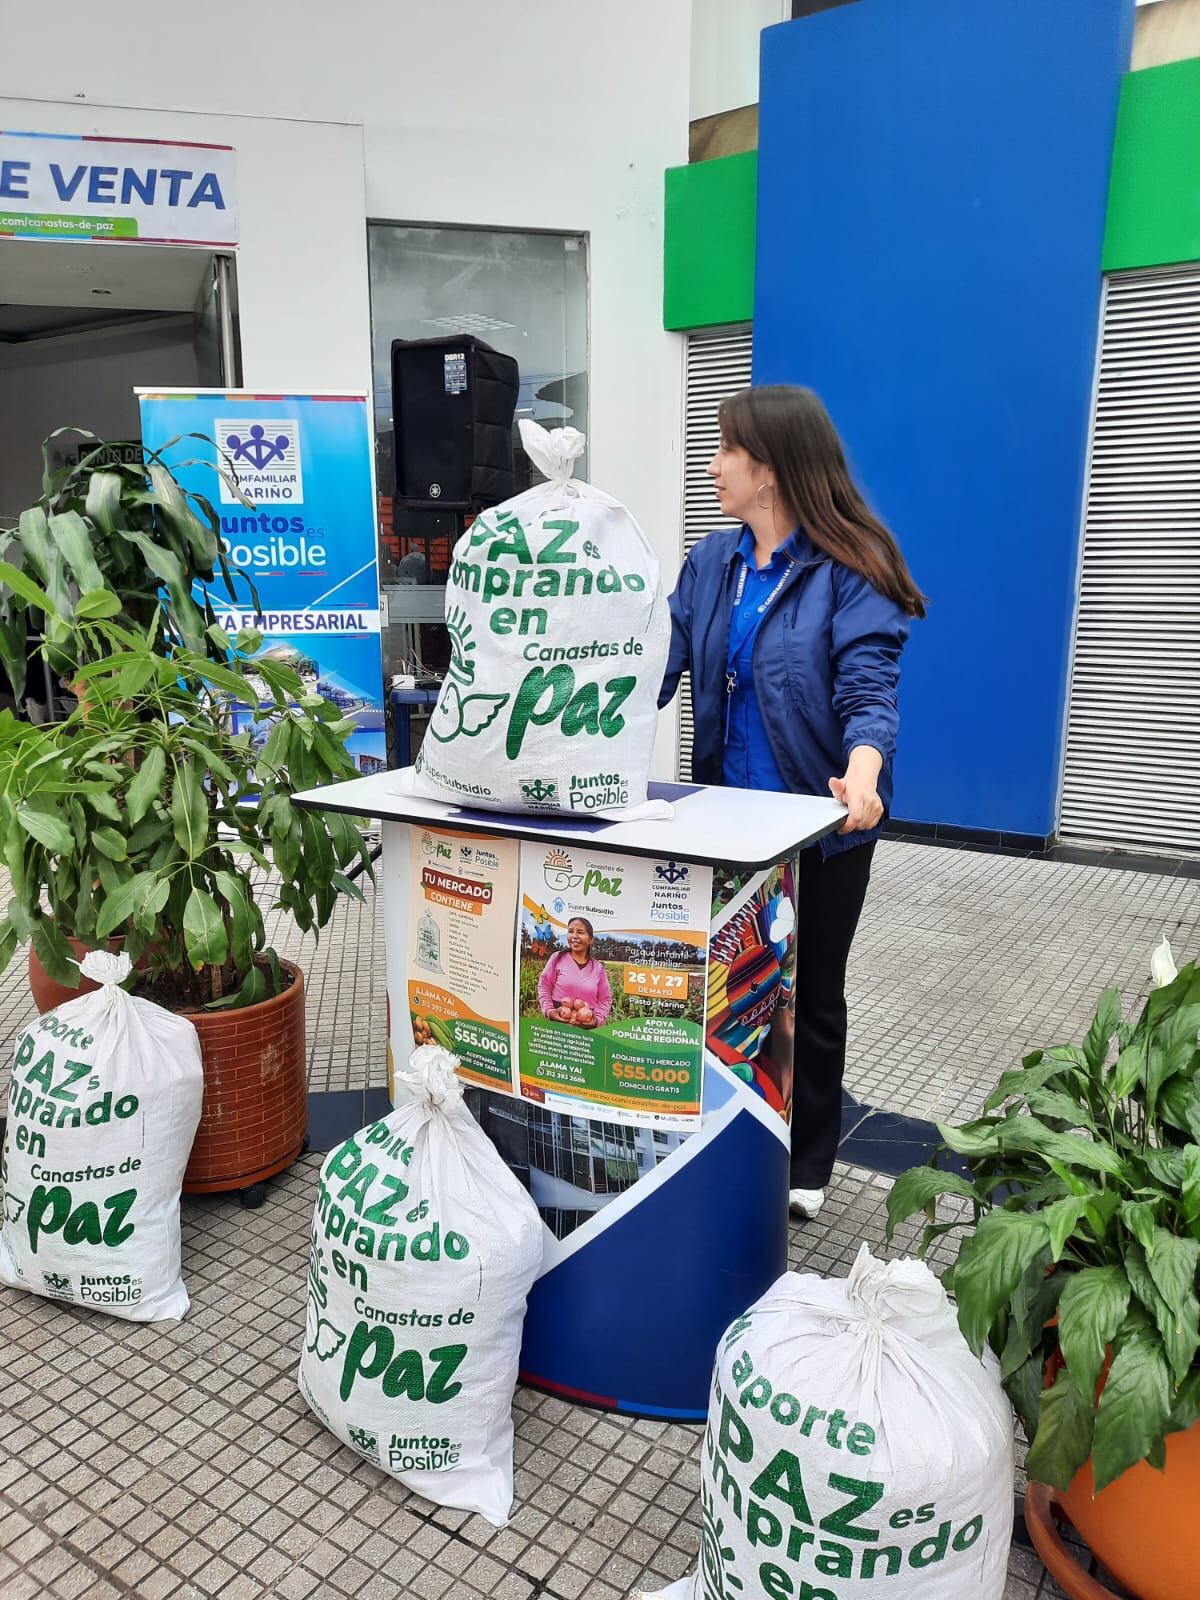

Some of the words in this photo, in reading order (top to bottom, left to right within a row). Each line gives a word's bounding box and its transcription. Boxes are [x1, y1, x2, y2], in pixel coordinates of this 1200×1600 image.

[49, 163, 226, 210] VENTA
[231, 484, 293, 499] ARIÑO
[221, 512, 305, 534] untos
[306, 528, 325, 539] es
[462, 516, 580, 565] PAZ
[582, 540, 601, 560] es
[449, 559, 646, 604] omprando
[241, 613, 368, 631] EMPRESARIAL
[489, 607, 549, 636] en
[522, 639, 620, 662] Canastas
[623, 637, 643, 656] de
[569, 773, 620, 790] Juntos
[620, 779, 628, 787] es
[570, 788, 629, 810] Posible
[475, 849, 496, 859] Juntos
[586, 861, 615, 872] Canastas
[615, 865, 624, 873] de
[424, 872, 436, 884] TU
[437, 877, 491, 899] MERCADO
[654, 890, 688, 900] NARIÑO
[430, 892, 473, 911] CONTIENE
[567, 902, 615, 916] SuperSubsidio
[651, 900, 684, 911] Juntos
[650, 909, 690, 922] Posible
[625, 946, 656, 957] Parque
[657, 949, 689, 960] Infantil
[628, 955, 683, 969] Comfamiliar
[628, 971, 647, 984] 26
[651, 974, 661, 986] Y
[665, 975, 684, 987] 27
[638, 986, 648, 994] DE
[649, 987, 673, 996] MAYO
[629, 997, 651, 1006] Pasto
[643, 1027, 688, 1037] ECONOMÍA
[645, 1019, 674, 1028] APOYA
[454, 1027, 508, 1056] $55.000
[612, 1029, 653, 1042] POPULAR
[653, 1035, 700, 1045] REGIONAL
[13, 1033, 93, 1102] PAZ
[87, 1075, 101, 1091] s
[611, 1053, 646, 1063] ADQUIERE
[655, 1059, 691, 1067] MERCADO
[612, 1060, 690, 1083] $55.000
[619, 1081, 655, 1091] DOMICILIO
[655, 1085, 680, 1094] GRATIS
[8, 1075, 139, 1129] mprando
[16, 1125, 46, 1158] en
[31, 1164, 115, 1183] Canastas
[119, 1157, 142, 1173] de
[325, 1136, 410, 1227] PAZ
[406, 1199, 429, 1223] es
[318, 1179, 470, 1262] mprando
[80, 1273, 132, 1287] Juntos
[132, 1278, 142, 1286] es
[331, 1248, 368, 1293] en
[81, 1286, 142, 1303] Posible
[354, 1296, 443, 1328] Canastas
[448, 1307, 475, 1327] de
[731, 1350, 876, 1456] aporte
[389, 1434, 450, 1450] Juntos
[388, 1448, 460, 1471] Posible
[718, 1394, 885, 1543] PAZ
[888, 1502, 936, 1529] es
[706, 1418, 984, 1580] omprando
[758, 1561, 839, 1600] en
